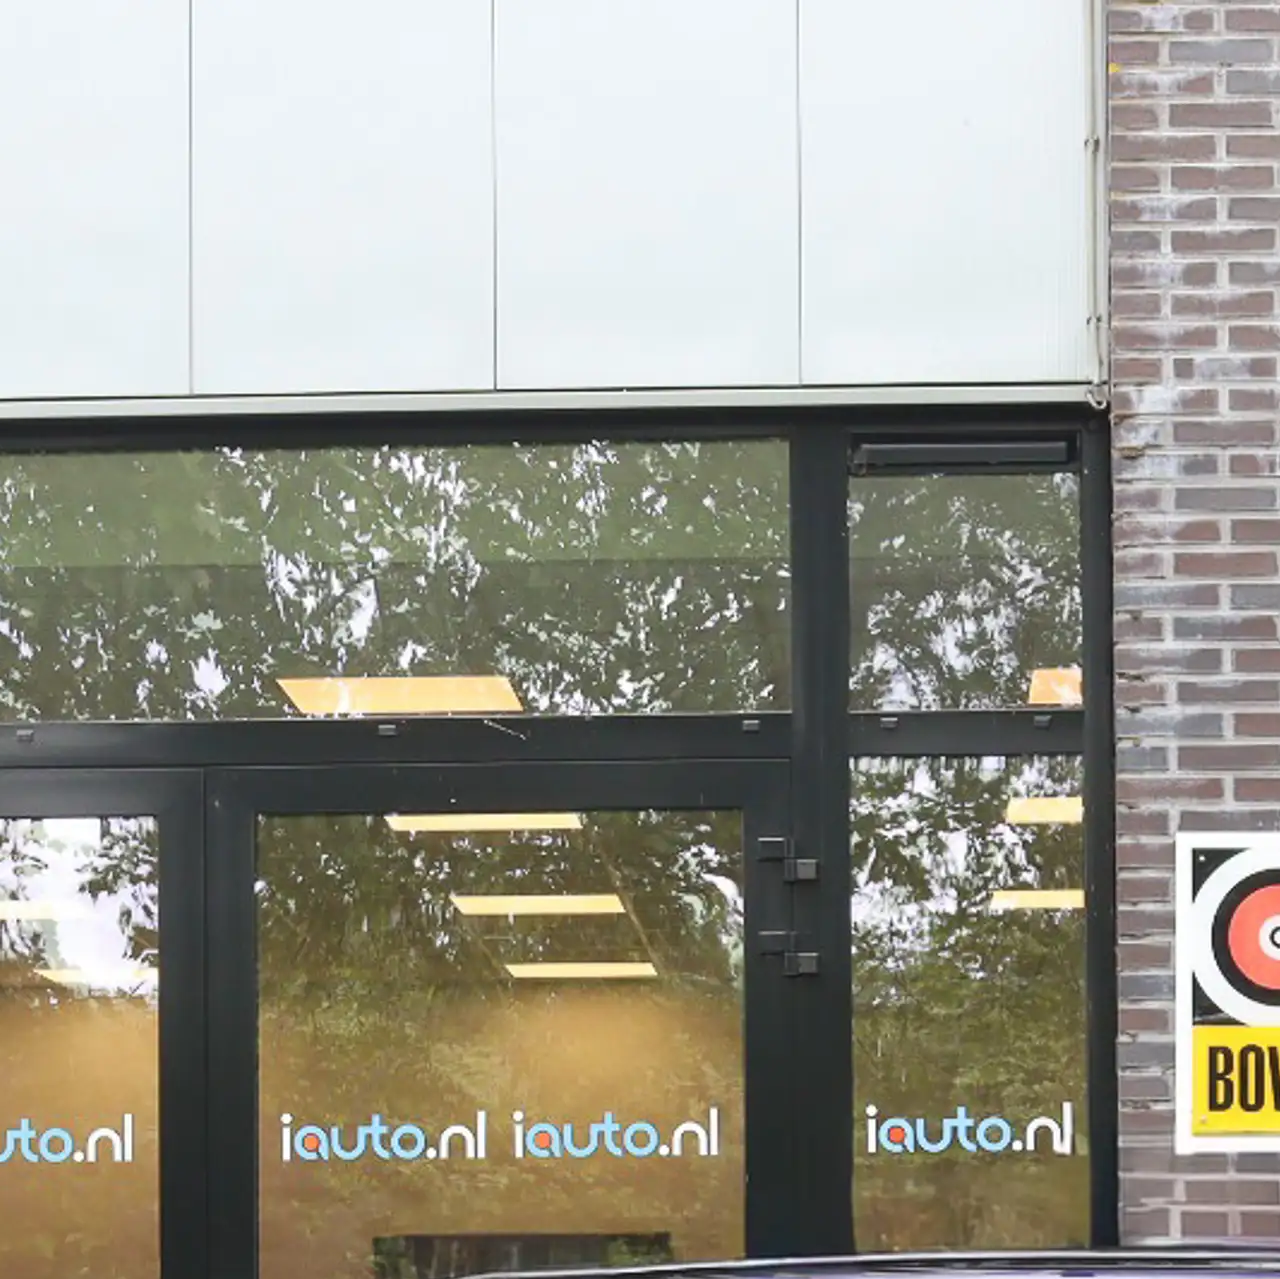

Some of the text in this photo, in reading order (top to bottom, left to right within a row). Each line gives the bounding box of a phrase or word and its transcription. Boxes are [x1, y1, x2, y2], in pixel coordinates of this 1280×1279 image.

[281, 1110, 486, 1161] iauto.nl
[513, 1107, 719, 1158] iauto.nl
[866, 1102, 1073, 1154] iauto.nl
